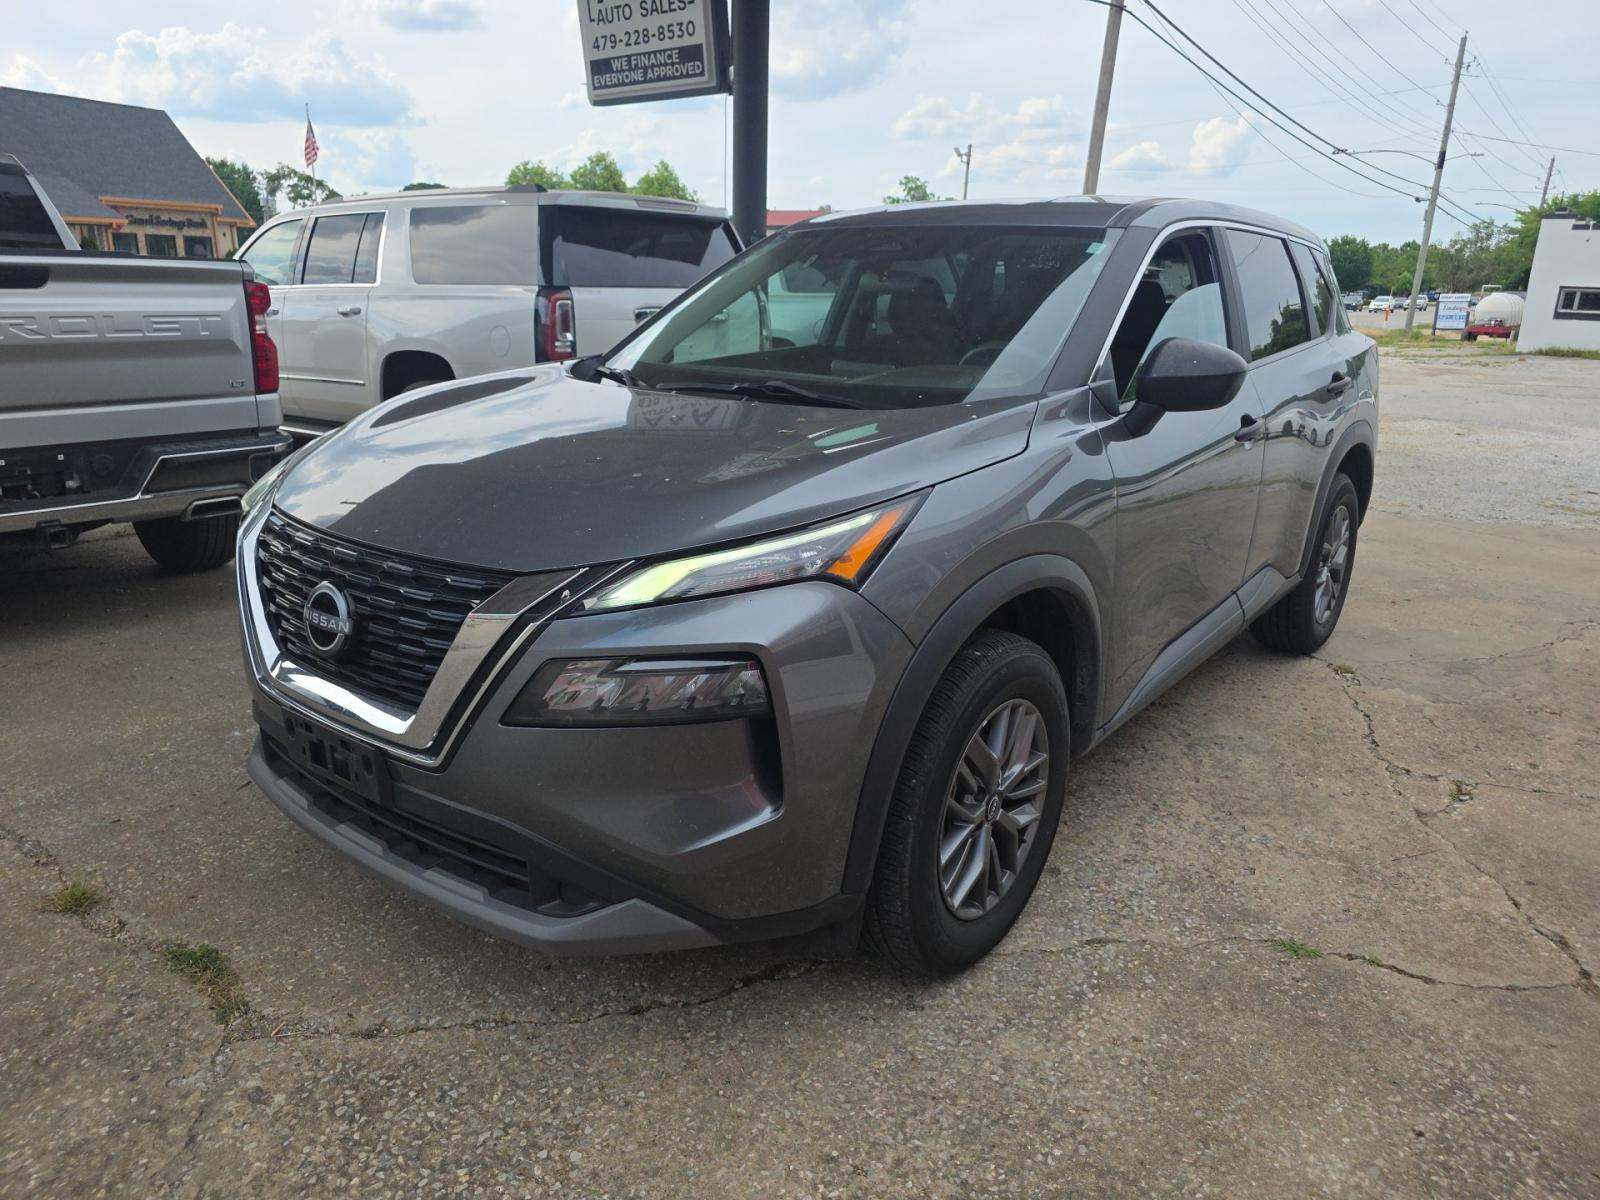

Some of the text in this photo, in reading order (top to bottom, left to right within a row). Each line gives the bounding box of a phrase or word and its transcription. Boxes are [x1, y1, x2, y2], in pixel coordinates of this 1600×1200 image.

[596, 0, 687, 26] AUTO SALES
[592, 20, 696, 52] 479-228-8530
[611, 50, 680, 71] WE FINANCE
[593, 61, 702, 88] EVERYONE APPROVED
[303, 608, 350, 633] NISSAN
